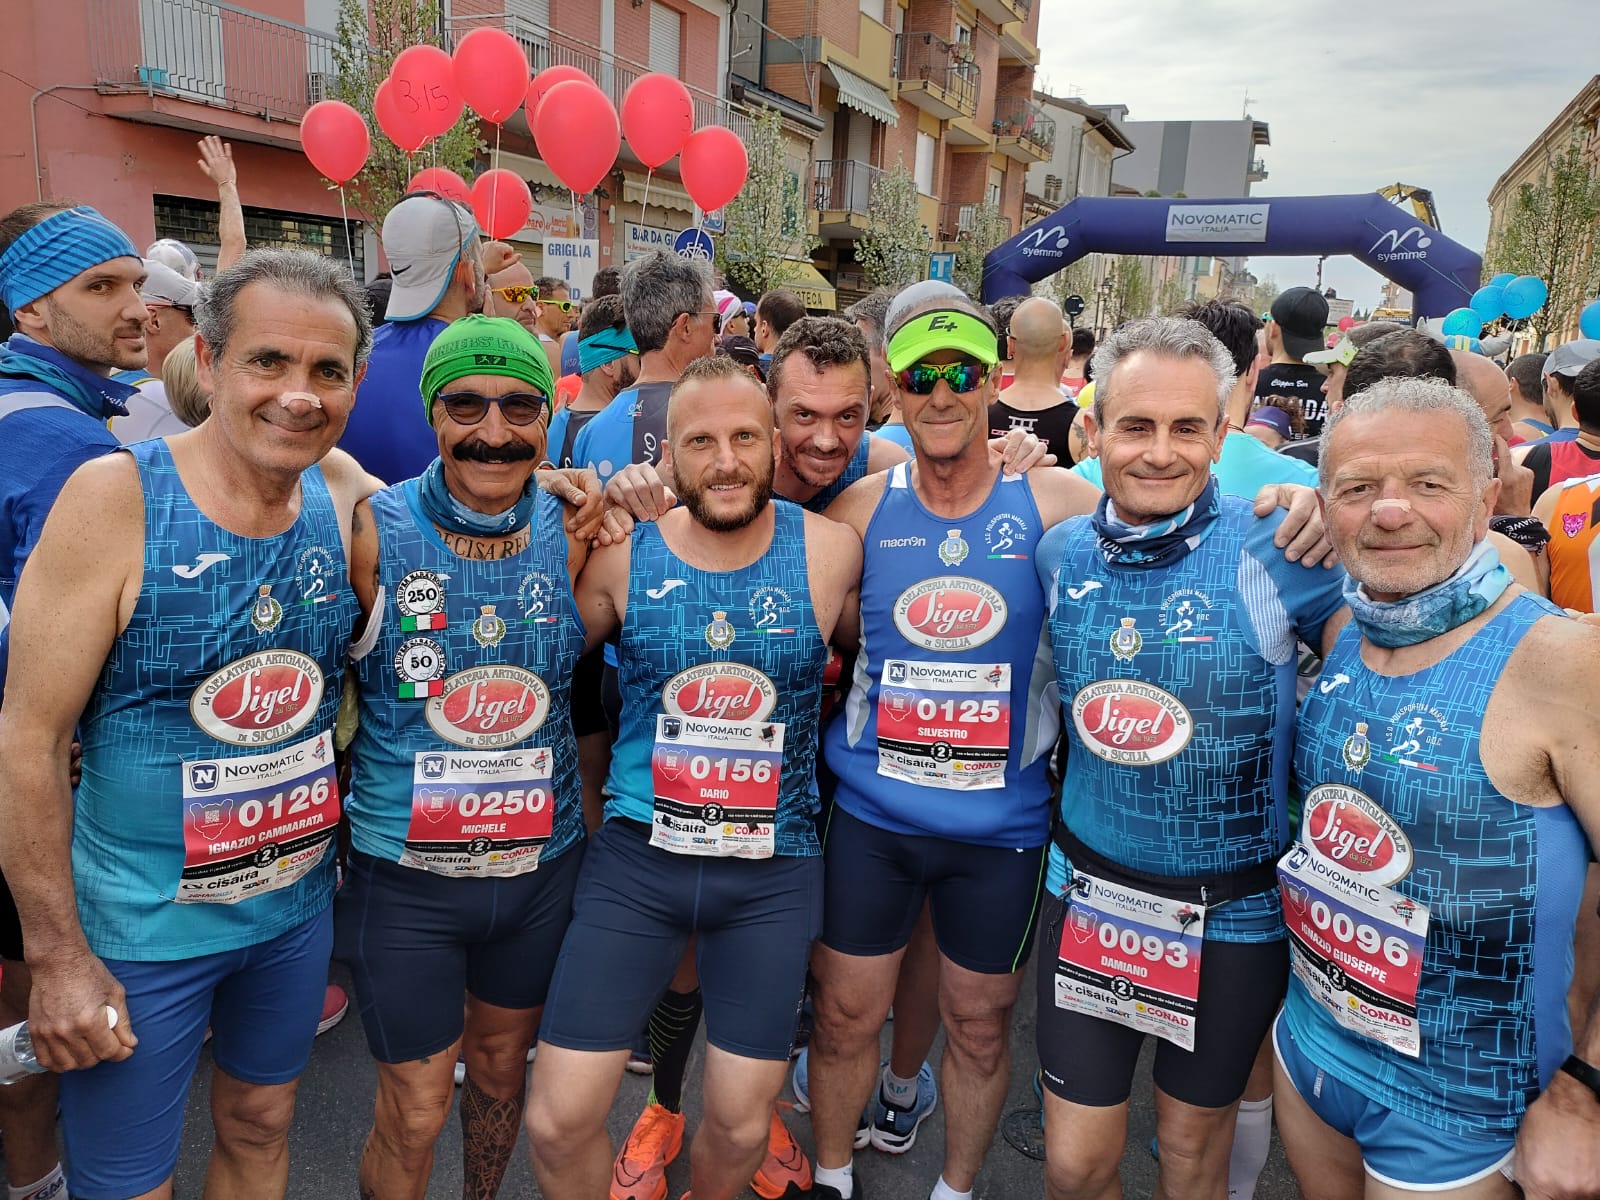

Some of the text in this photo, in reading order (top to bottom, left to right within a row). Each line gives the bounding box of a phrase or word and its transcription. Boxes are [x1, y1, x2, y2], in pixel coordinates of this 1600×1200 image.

[1171, 212, 1263, 226] NOVOMATIC
[632, 227, 649, 242] BAR
[651, 231, 662, 244] DA
[548, 243, 591, 258] GRIGLIA
[1022, 246, 1064, 258] syemme
[1377, 250, 1428, 263] syemme
[563, 261, 570, 280] 1
[793, 290, 822, 306] OTECA
[408, 588, 437, 603] 250
[911, 590, 988, 634] Sigel
[934, 637, 972, 649] SICILIA
[411, 655, 432, 668] 50
[205, 656, 263, 695] GELATERIA
[265, 654, 319, 685] ARTIGIANALE
[910, 666, 977, 679] NOVOMATIC
[490, 669, 545, 701] ARTIGIANALE
[219, 668, 304, 724] Sigel
[452, 679, 529, 729] Sigel
[682, 676, 755, 719] Sigel
[1078, 684, 1123, 707] GELATERIA
[1125, 684, 1186, 725] ARTIGIANALE
[917, 698, 1000, 723] 0125
[1088, 694, 1168, 745] Sigel
[238, 722, 293, 742] DI SICILIA
[478, 731, 517, 745] SICILIA
[686, 722, 752, 737] NOVOMATIC
[918, 727, 968, 739] SILVESTRO
[938, 748, 945, 757] 2
[1100, 748, 1150, 761] DI SICILIA
[225, 750, 305, 778] NOVOMATIC
[451, 757, 523, 769] NOVOMATIC
[690, 755, 771, 783] 0156
[897, 756, 937, 769] cisalfa
[964, 762, 1001, 771] CONAD
[257, 770, 282, 780] ITALIA
[700, 788, 730, 799] DARIO
[238, 777, 329, 828] 0126
[458, 788, 546, 817] 0250
[708, 808, 717, 819] 2
[1309, 789, 1349, 808] GELATERIA
[1350, 793, 1406, 853] ARTIGIANALE
[208, 835, 255, 856] IGNAZIO
[258, 813, 323, 845] CAMMARATA
[461, 823, 506, 834] MICHELE
[734, 825, 770, 835] COAD
[1311, 800, 1388, 860] Sigel
[261, 849, 271, 861] 2
[290, 841, 328, 865] CONAD
[474, 842, 484, 852] 2
[501, 847, 538, 860] CONAD
[424, 855, 471, 864] cisalfa
[207, 870, 259, 890] cisalfa
[1307, 857, 1380, 901] NOVOMATIC
[1328, 880, 1351, 897] ITALIA
[1095, 885, 1163, 914] NOVOMATIC
[1115, 902, 1137, 913] ITALIA
[1310, 900, 1409, 967] 0096
[1099, 922, 1188, 968] 0093
[1301, 921, 1332, 955] IGNAZIO
[1333, 946, 1388, 984] GIUSEPPE
[1101, 955, 1148, 978] DAMIANO
[1331, 969, 1341, 982] 2
[1075, 986, 1118, 1006] cisalfa
[1117, 982, 1127, 994] 2
[1147, 1006, 1189, 1027] CONAD
[1359, 1004, 1412, 1027] CONAD
